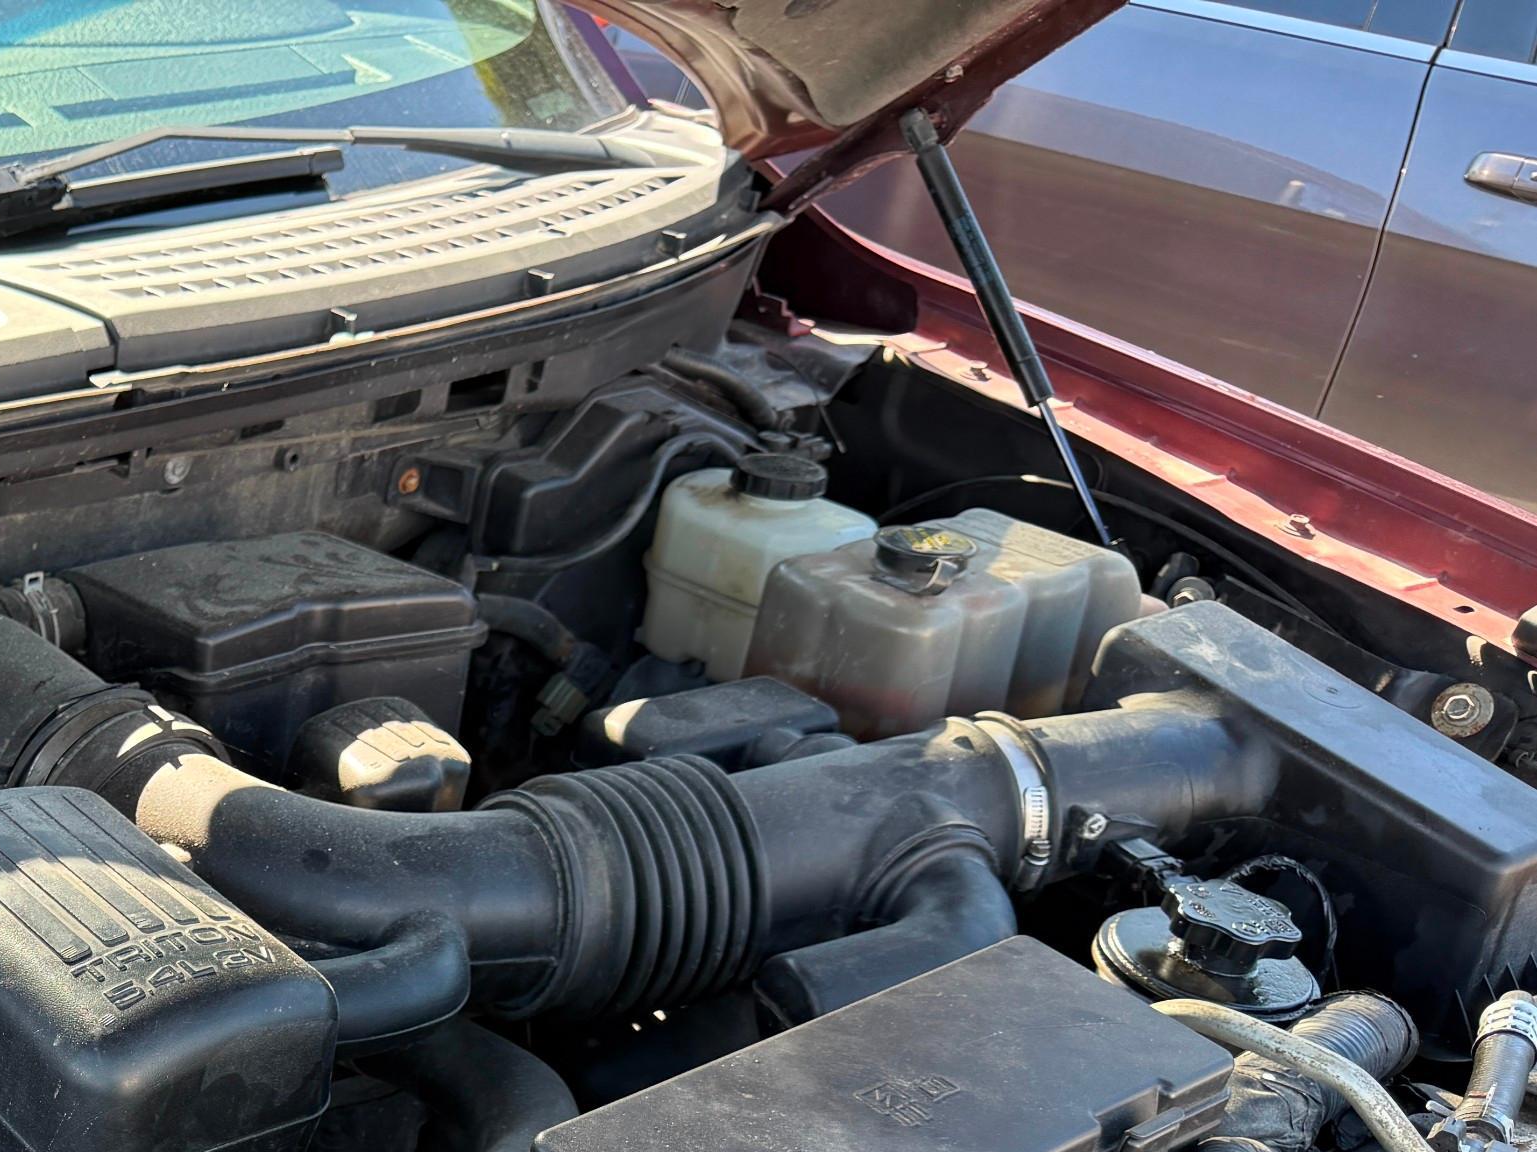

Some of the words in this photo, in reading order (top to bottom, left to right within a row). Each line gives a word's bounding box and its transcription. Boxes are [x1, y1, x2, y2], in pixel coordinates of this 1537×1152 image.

[70, 924, 263, 982] TRITON
[103, 960, 217, 1010] 5.4L
[214, 946, 275, 968] 3V
